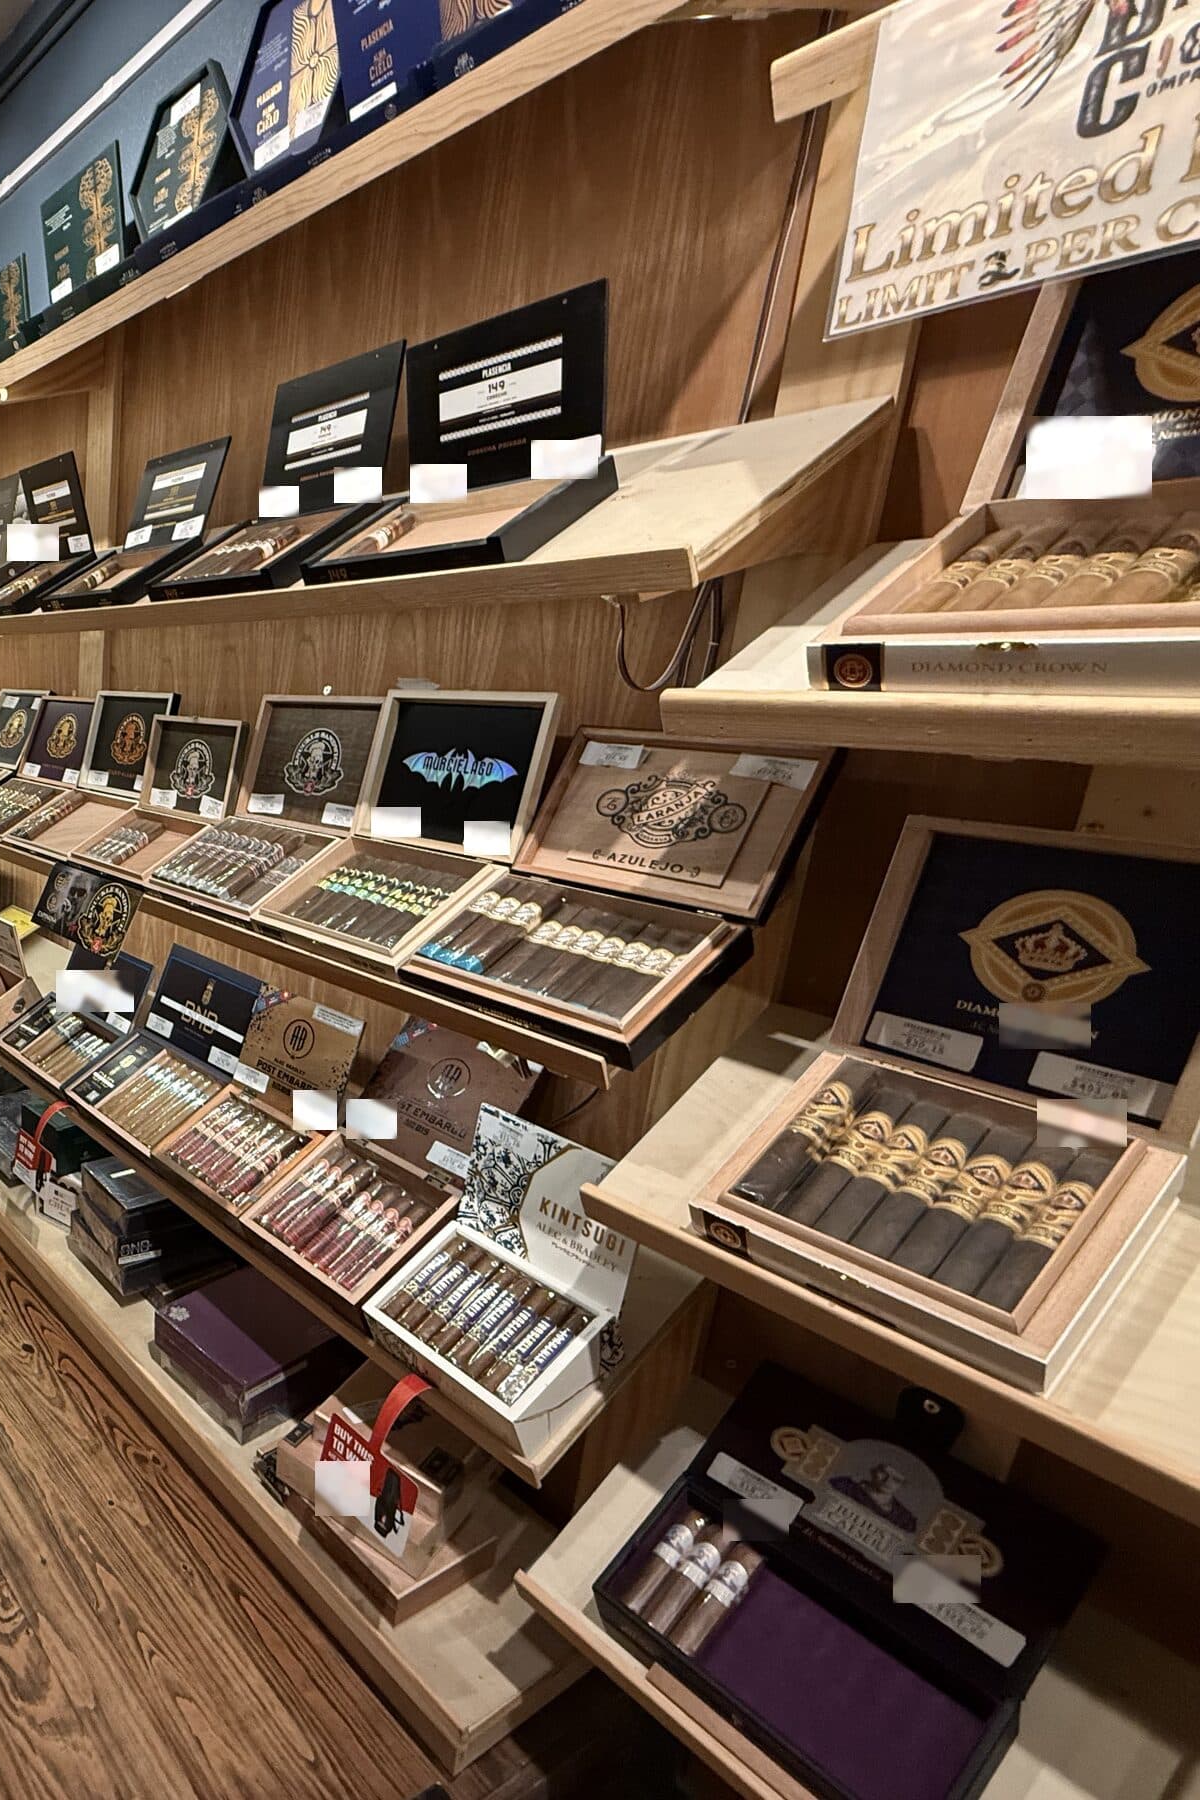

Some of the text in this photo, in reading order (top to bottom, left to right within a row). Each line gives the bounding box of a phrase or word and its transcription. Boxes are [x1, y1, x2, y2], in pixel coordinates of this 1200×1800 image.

[369, 54, 393, 81] CIELO
[844, 122, 1165, 284] Limited
[834, 260, 975, 330] LIMIT
[1020, 212, 1141, 280] PER
[487, 380, 506, 394] 149
[911, 661, 1108, 674] DIAMOND CROWN
[423, 756, 494, 777] MURCIELAGO
[636, 790, 703, 823] LARANJA
[607, 852, 684, 874] AZULEJO
[256, 1059, 276, 1076] POST
[539, 1196, 625, 1257] KINTSUGI
[569, 1239, 617, 1272] BRADLEY
[332, 1436, 345, 1455] TO
[333, 1423, 353, 1443] BUY
[353, 1439, 375, 1462] THIS
